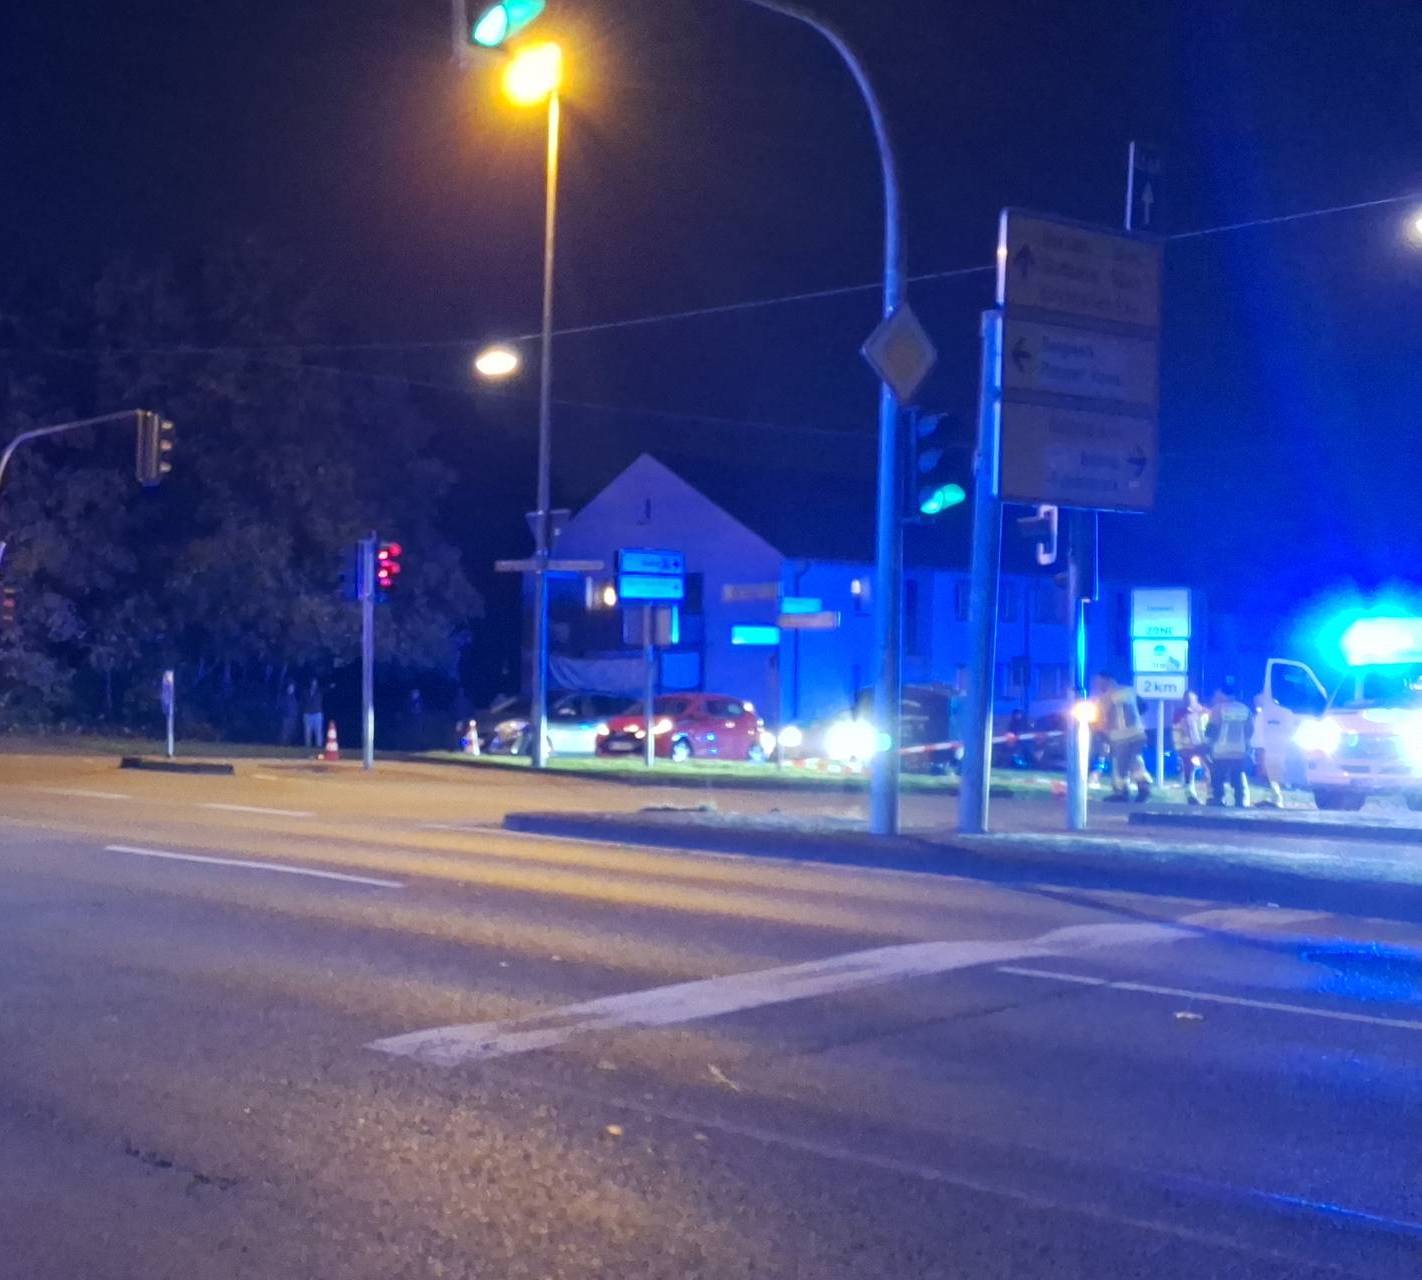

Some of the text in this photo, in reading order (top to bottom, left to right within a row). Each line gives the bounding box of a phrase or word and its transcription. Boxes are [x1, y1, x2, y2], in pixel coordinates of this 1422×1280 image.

[1145, 626, 1173, 635] ZONE
[1144, 680, 1178, 692] 2 km
